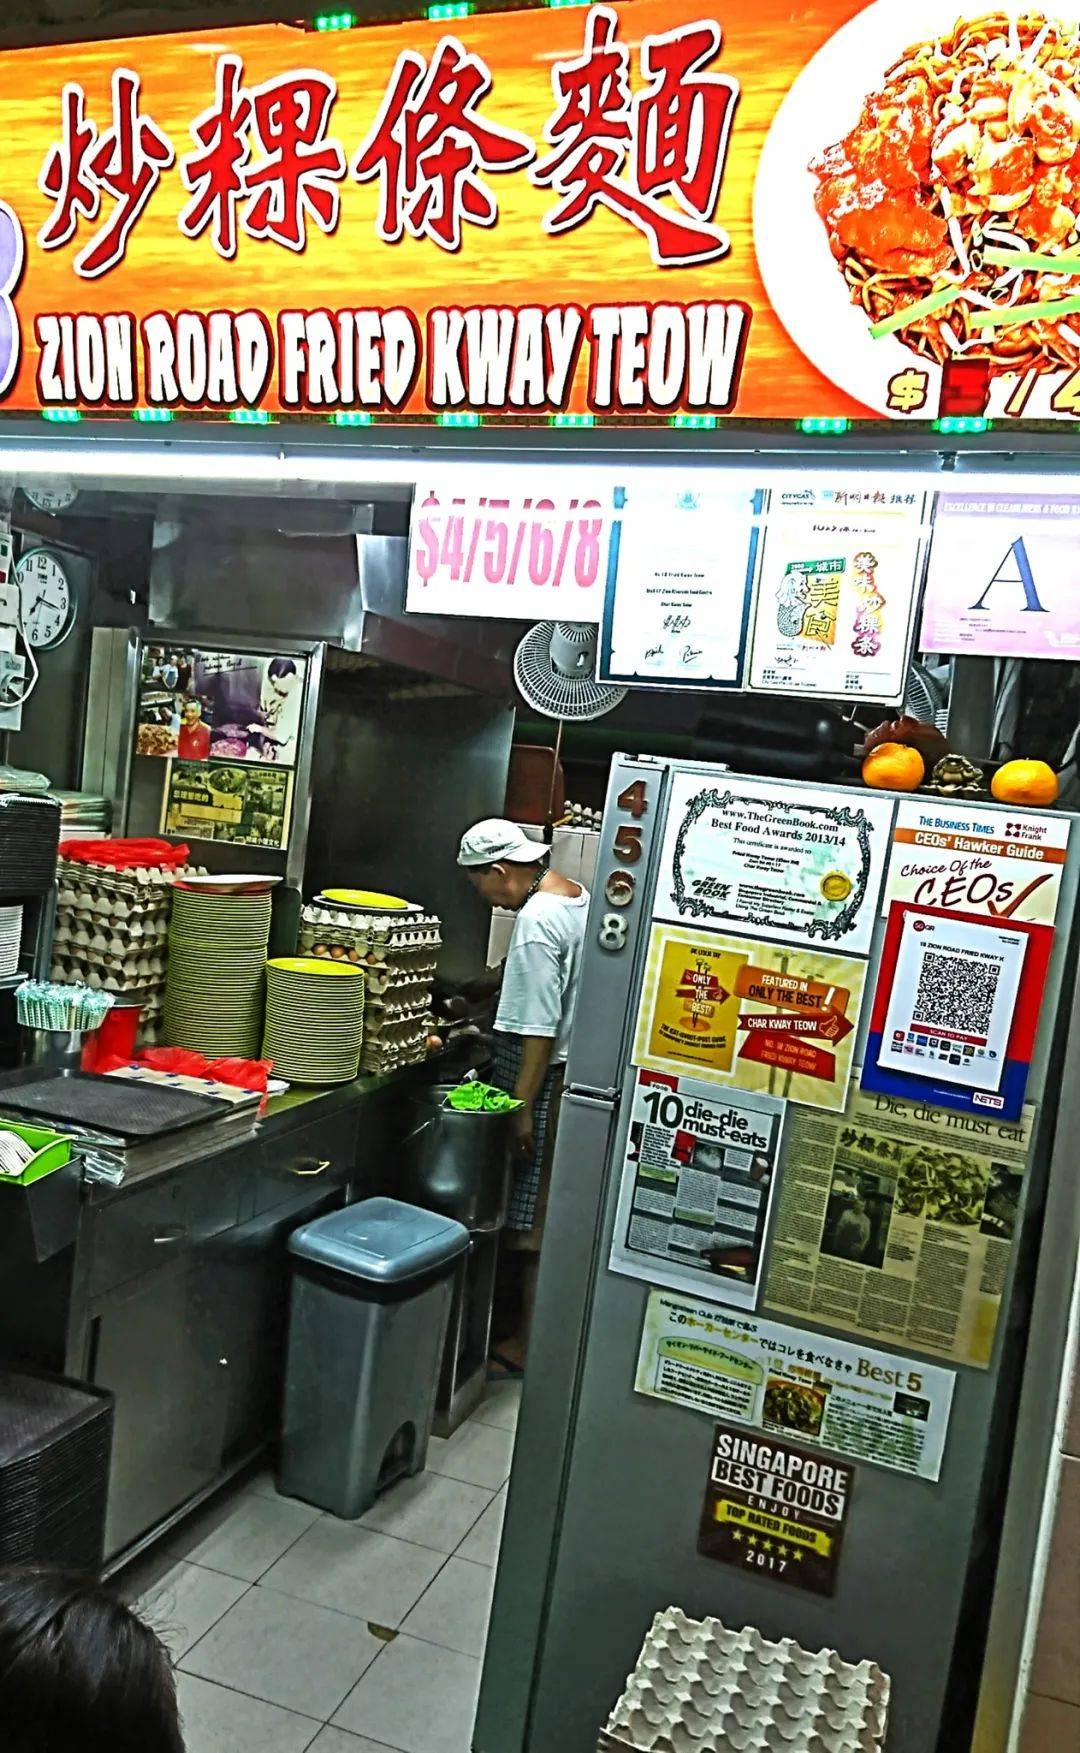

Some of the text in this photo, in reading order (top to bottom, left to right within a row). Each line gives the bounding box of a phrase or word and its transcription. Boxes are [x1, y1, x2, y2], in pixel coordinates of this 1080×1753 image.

[38, 7, 740, 279] 炒粿條麵
[38, 303, 749, 410] ZION ROAD FRIED KWAY TEOW
[416, 490, 603, 588] $4/5/6/8
[25, 559, 33, 572] 11
[37, 556, 47, 569] 12
[57, 577, 64, 590] 2
[967, 536, 1051, 613] A
[59, 597, 66, 609] 3
[54, 614, 60, 626] 4
[31, 628, 38, 640] 6
[44, 625, 51, 638] 5
[617, 780, 648, 819] 4
[722, 809, 839, 833] www.TheGreenBook.com
[919, 815, 995, 834] THE BUSINESS TIMES
[1022, 824, 1048, 834] Knight
[711, 818, 846, 847] Best Food Awards 2013/14
[1021, 831, 1042, 841] Frank
[612, 825, 644, 863] 5
[746, 839, 773, 850] certificate
[780, 844, 804, 854] awarded
[915, 831, 1044, 860] CEOs' Hawker Guide
[901, 857, 993, 877] Choice Of the
[605, 868, 636, 907] 6
[692, 879, 732, 891] GREEN
[694, 887, 731, 898] BOOK
[914, 873, 1015, 907] CEOs
[599, 912, 629, 951] 8
[927, 942, 942, 950] ZION
[942, 945, 960, 953] ROAD
[960, 949, 979, 957] FRIED
[980, 952, 999, 960] KWAY
[692, 973, 712, 985] ONLY
[761, 974, 809, 992] FEATURED IN
[695, 988, 708, 1000] THE
[748, 985, 776, 1000] ONLY
[776, 988, 795, 1003] THE
[747, 1018, 817, 1031] CHAR KWAY TEOW
[929, 1029, 947, 1037] SCAN
[643, 1091, 684, 1129] 10
[974, 1094, 1002, 1107] NETS
[685, 1101, 749, 1130] die-die
[875, 1094, 907, 1118] Die,
[913, 1103, 941, 1124] die
[946, 1112, 993, 1136] must
[998, 1124, 1026, 1143] eat
[682, 1118, 767, 1149] must-eats
[856, 1357, 905, 1389] Best
[905, 1372, 924, 1393] 5
[717, 1433, 849, 1494] SINGAPORE
[715, 1459, 840, 1517] BEST FOODS
[747, 1495, 801, 1520] ENJOY
[726, 1503, 818, 1544] TOP RATED FOODS
[746, 1549, 787, 1573] 2017
